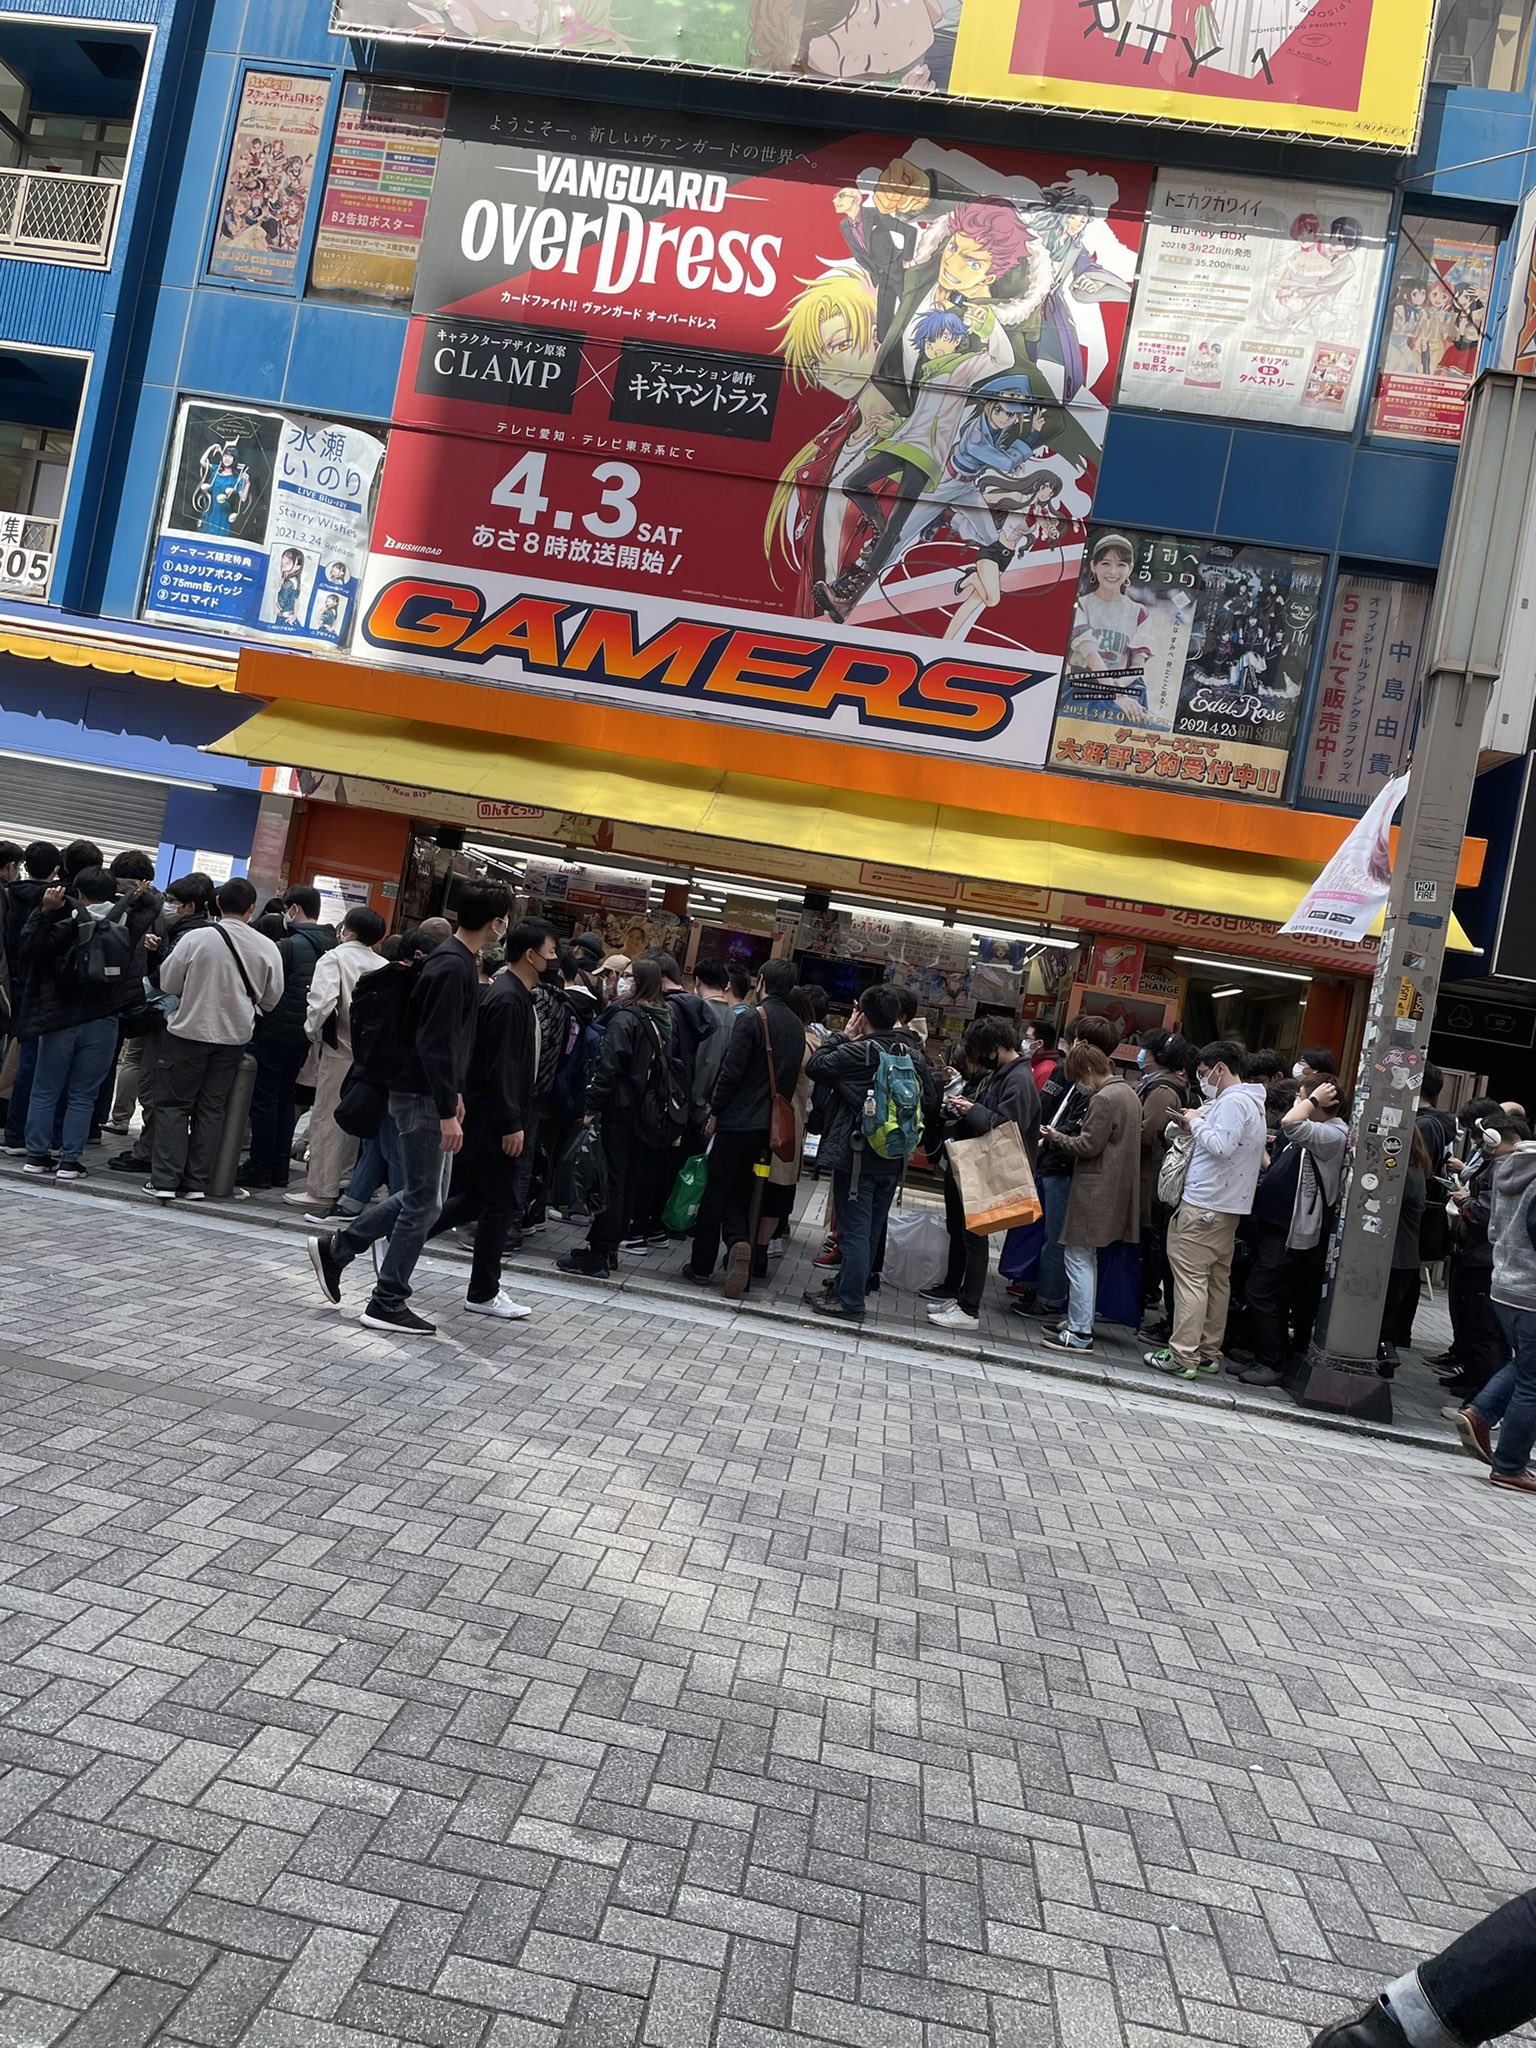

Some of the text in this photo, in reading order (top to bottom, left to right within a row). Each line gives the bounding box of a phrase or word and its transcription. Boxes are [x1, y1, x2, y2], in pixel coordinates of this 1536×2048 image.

[1250, 26, 1287, 34] WONDER
[1308, 20, 1349, 29] PRIORITY
[1354, 121, 1408, 136] ANIPLEX
[536, 154, 728, 213] VANGUARD
[1165, 190, 1262, 217] トニカクカワイイ
[331, 210, 415, 231] B2告知ポスター
[1219, 231, 1247, 241] BOX
[460, 199, 783, 297] overDress
[582, 302, 642, 320] ヴァンガード
[646, 310, 718, 331] オーバードレス
[437, 329, 567, 358] キャラクターデザイン原案
[434, 347, 562, 390] CLAMP
[1133, 361, 1184, 374] 告知ポスター
[1153, 356, 1167, 364] B2
[1251, 355, 1289, 367] メモリアル
[1262, 365, 1275, 374] B2
[650, 360, 757, 386] アニメーション制作
[1240, 374, 1295, 387] タペストリー
[628, 373, 769, 417] キネマシトラス
[287, 426, 347, 463] 水瀬
[283, 452, 361, 496] いのり
[297, 486, 317, 499] LIVE
[490, 451, 683, 547] 4.3 SAT
[279, 505, 314, 526] Starry
[319, 517, 358, 539] Wishes
[170, 545, 253, 568] ゲーマーズ限定特典
[325, 542, 356, 559] Release
[394, 541, 443, 556] BUSHIROAD
[0, 547, 49, 582] 05
[174, 563, 254, 583] A3クリアポスター
[172, 577, 243, 597] 75mm缶バッジ
[170, 591, 220, 608] ブロマイド
[363, 577, 1048, 741] GAMERS
[1314, 593, 1361, 781] 5Fにて販売中!
[1338, 597, 1382, 785] オフィシャルファンクラブグッズ
[1063, 704, 1114, 721] 2021.3.12
[1189, 688, 1286, 724] Edel Rose
[1367, 640, 1413, 779] 中島由貴
[1179, 717, 1237, 737] 2021.4.23
[1114, 727, 1220, 758] ゲーマーズにて
[1055, 738, 1281, 794] 大好評予約受付中!!
[393, 787, 410, 798] Non
[1417, 882, 1434, 899] HOT FIRE
[1138, 980, 1180, 994] CHANGE
[1143, 973, 1172, 983] MONEY
